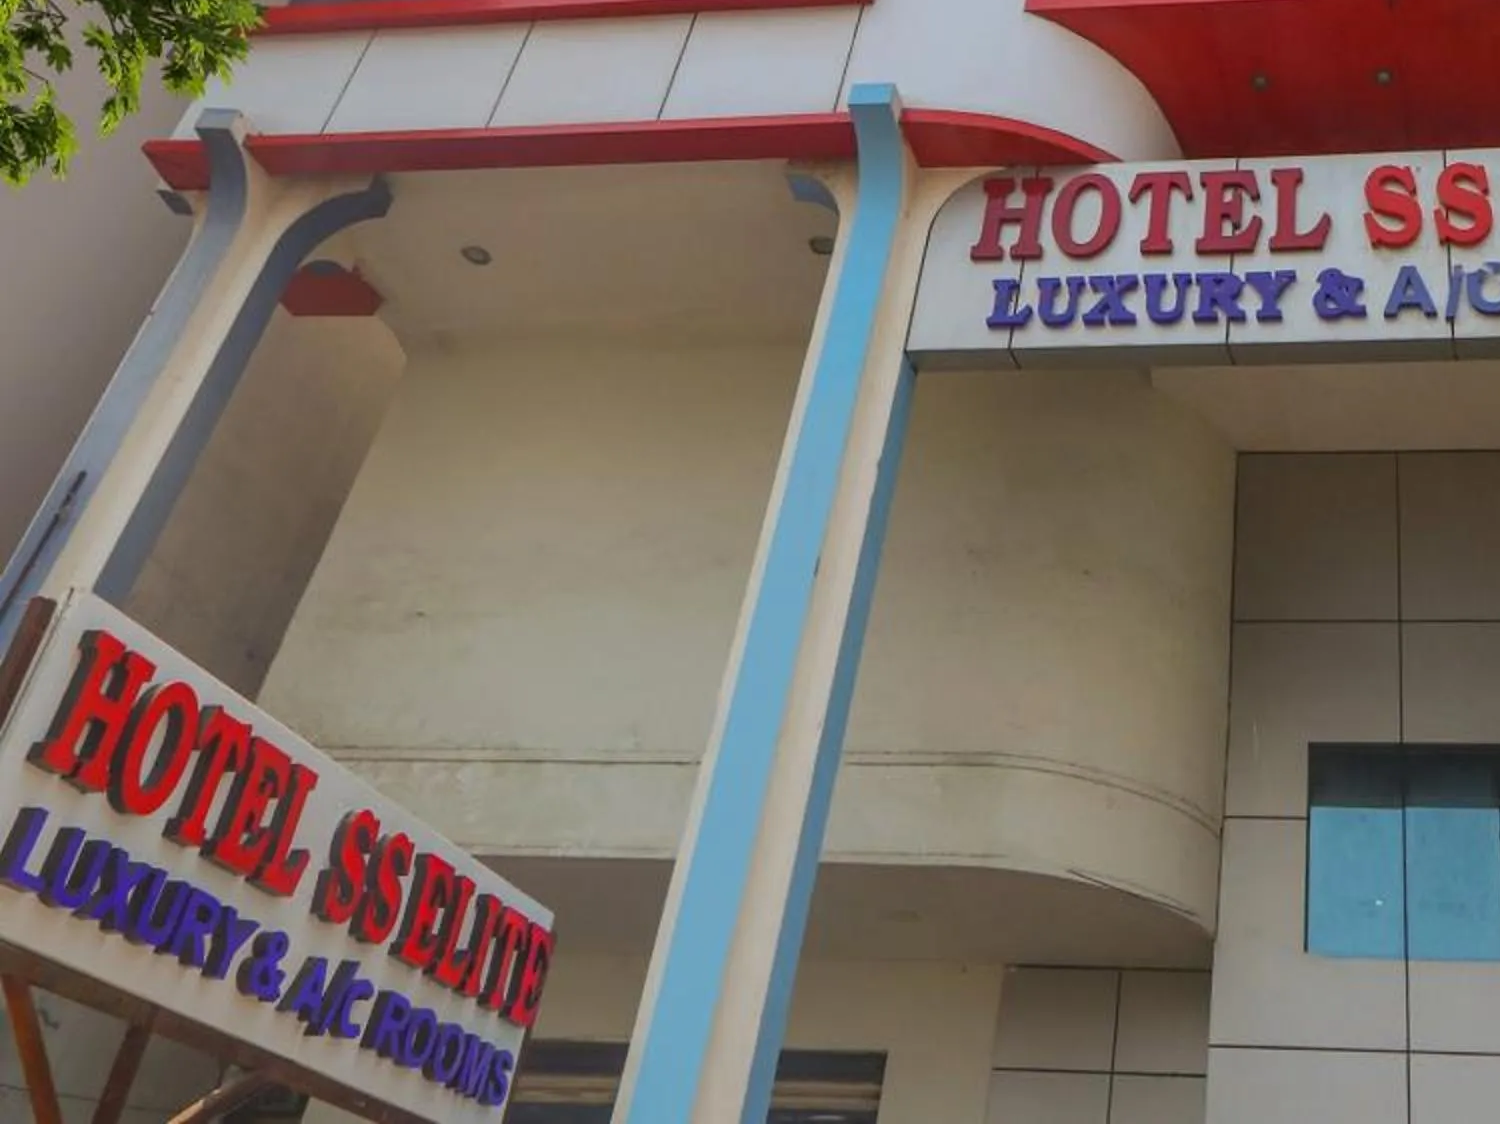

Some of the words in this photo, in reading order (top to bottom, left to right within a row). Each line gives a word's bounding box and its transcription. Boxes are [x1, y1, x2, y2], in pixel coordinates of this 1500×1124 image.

[970, 167, 1332, 261] HOTEL
[1363, 162, 1494, 249] SS
[986, 270, 1297, 330] LUXURY
[1312, 266, 1367, 322] &
[26, 629, 319, 898] HOTEL
[0, 806, 261, 980] LUXURY
[235, 930, 290, 1003] &
[275, 955, 375, 1039] A/C
[360, 989, 513, 1108] ROOMS
